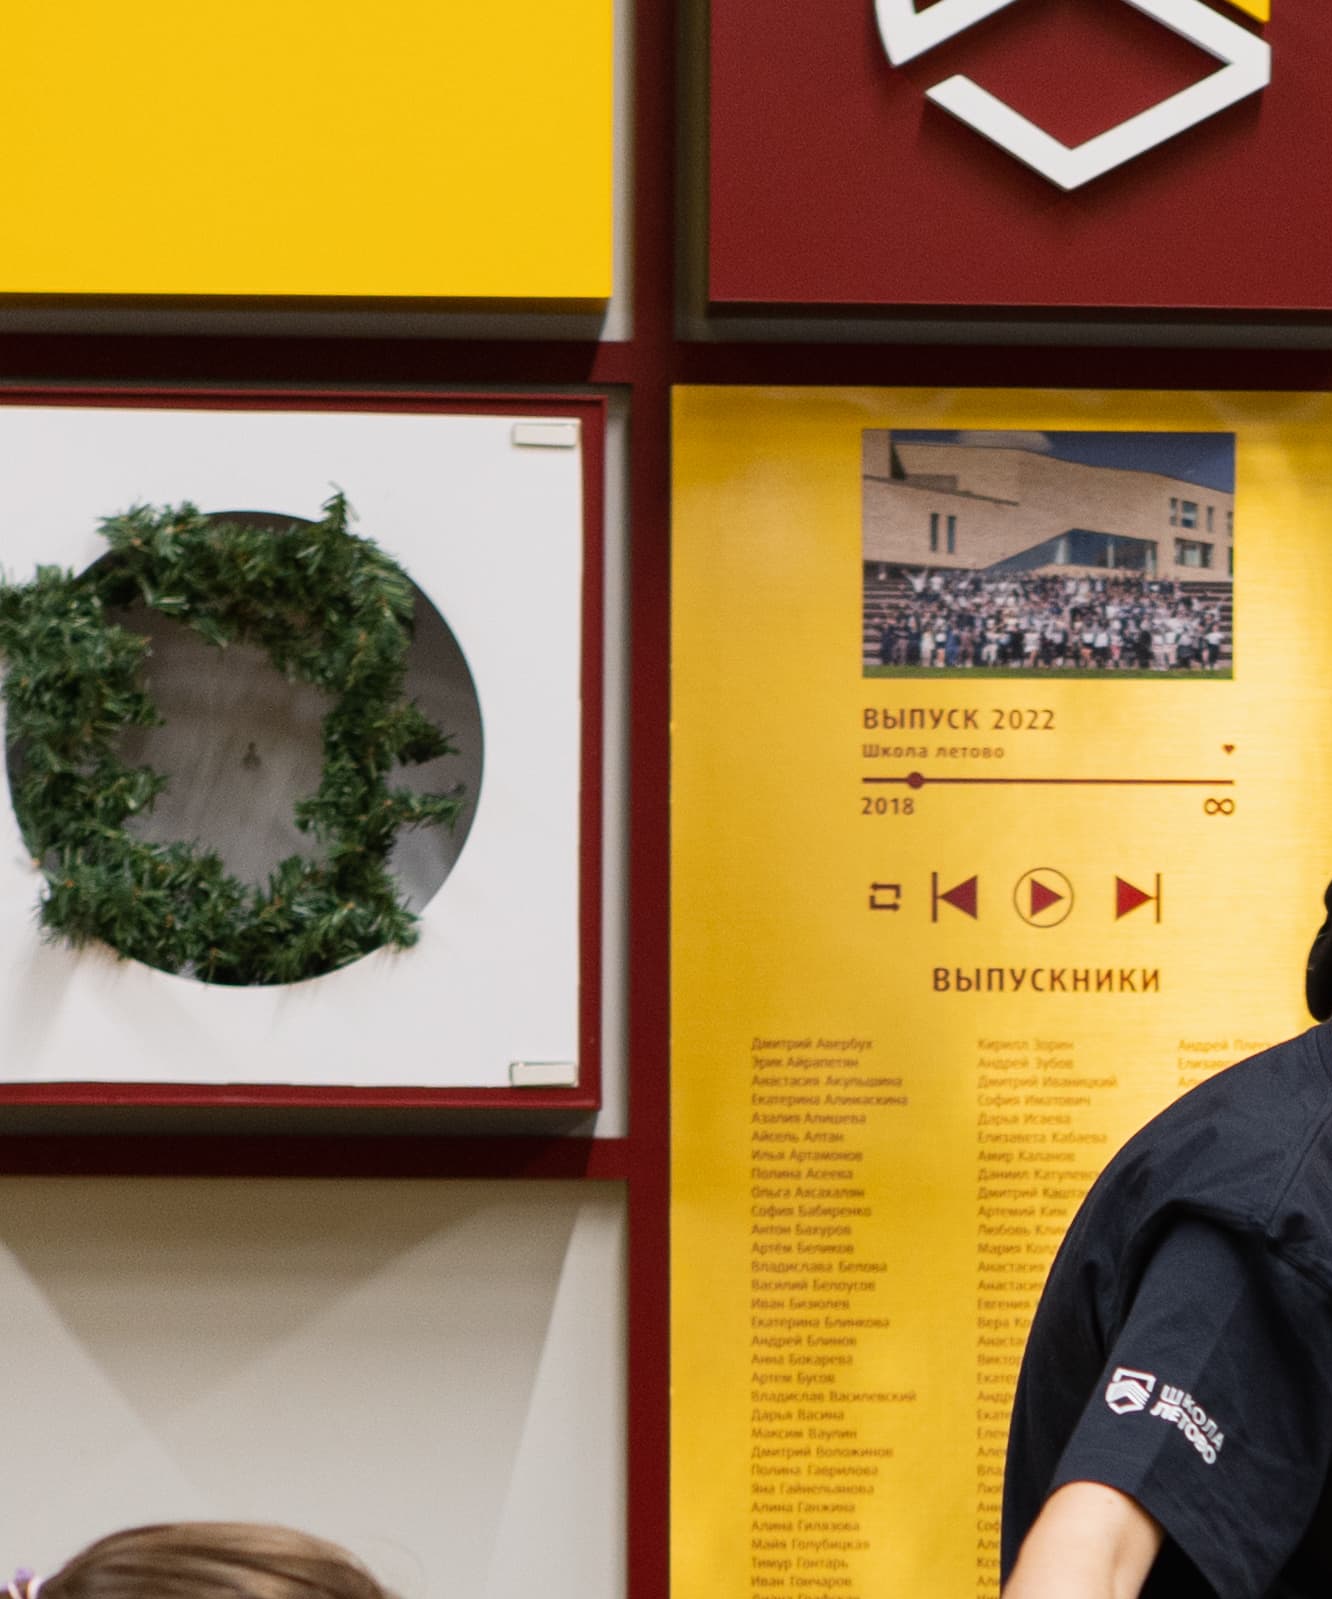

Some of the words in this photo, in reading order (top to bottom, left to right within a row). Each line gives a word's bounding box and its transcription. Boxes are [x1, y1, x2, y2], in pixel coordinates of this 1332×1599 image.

[862, 707, 979, 730] ВЫПУСК
[992, 709, 1055, 731] 2022
[862, 743, 929, 759] Школа
[935, 746, 1005, 759] летово
[861, 796, 915, 815] 2018
[932, 967, 1160, 993] ВЫПУСКНИКИ
[1159, 1384, 1225, 1452] ШКОЛА
[1149, 1400, 1217, 1465] ЛЕТОВО
